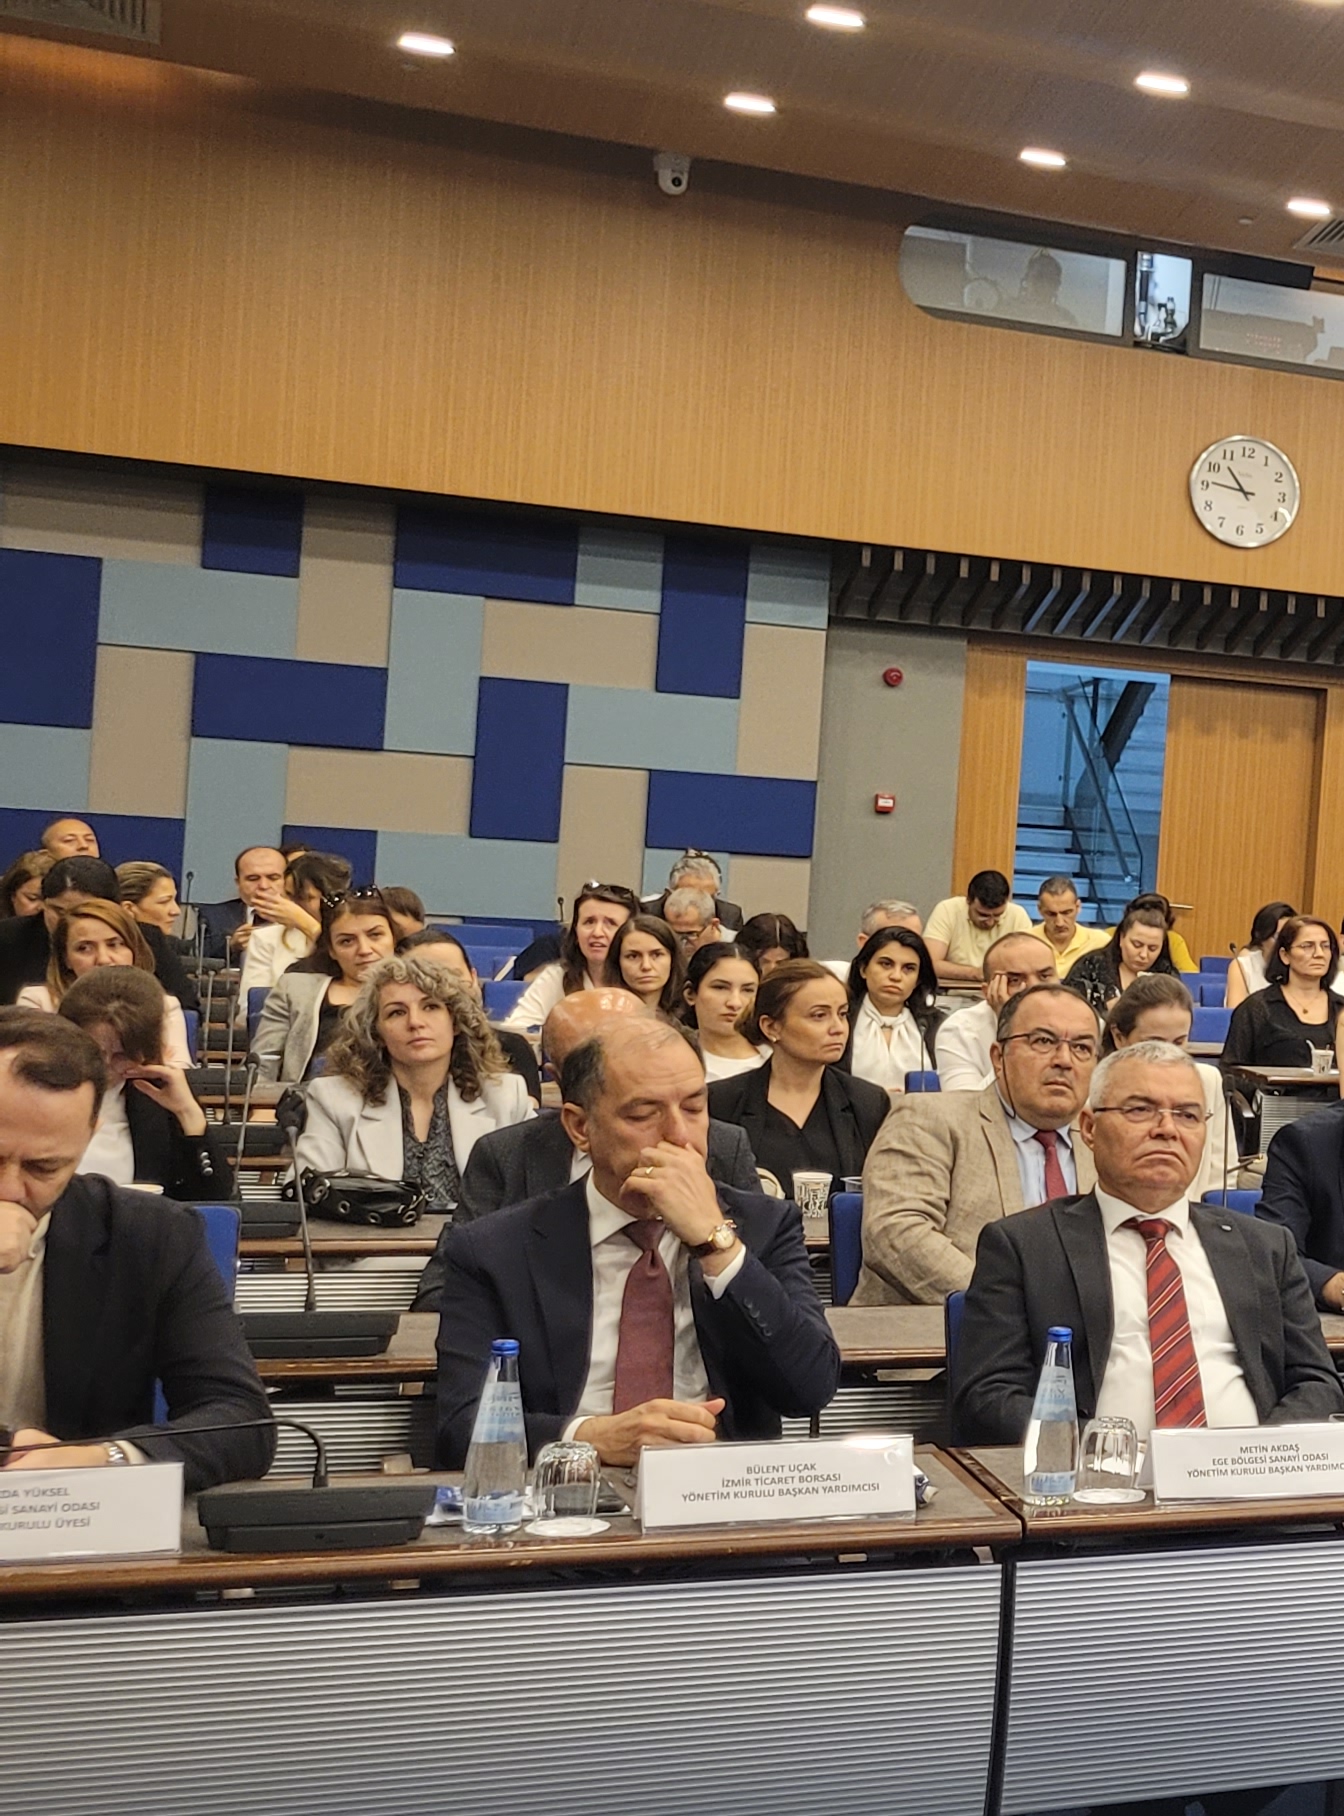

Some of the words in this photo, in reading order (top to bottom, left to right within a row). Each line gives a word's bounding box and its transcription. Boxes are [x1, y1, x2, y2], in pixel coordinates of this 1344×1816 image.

[1222, 449, 1235, 461] 11
[1241, 446, 1256, 459] 12
[1263, 455, 1270, 467] 1
[1207, 461, 1221, 474] 10
[1274, 471, 1284, 483] 2
[1201, 479, 1210, 491] 9
[1277, 492, 1287, 504] 3
[1203, 500, 1213, 512] 8
[1217, 516, 1226, 528] 7
[1270, 510, 1279, 522] 4
[1235, 525, 1245, 536] 6
[1255, 523, 1264, 535] 5
[1240, 1443, 1268, 1454] METİN
[1270, 1444, 1300, 1455] AKDAŞ
[1212, 1458, 1229, 1466] EGE
[1231, 1454, 1267, 1466] BÖLGESİ
[1269, 1452, 1300, 1464] SANAYİ
[1302, 1452, 1329, 1462] ODASI
[746, 1463, 786, 1474] BÜLENT
[788, 1462, 817, 1474] UÇAK
[1187, 1466, 1229, 1479] YÖNETİM
[1230, 1466, 1266, 1476] KURULU
[1268, 1464, 1304, 1476] BAŞKAN
[721, 1474, 752, 1488] İZMİR
[754, 1474, 796, 1487] TİCARET
[798, 1472, 842, 1486] BORSASI
[24, 1487, 71, 1498] YÜKSEL
[682, 1489, 731, 1503] YÖNETİM
[734, 1488, 775, 1500] KURULU
[778, 1486, 820, 1499] BAŞKAN
[821, 1482, 880, 1496] YARDIMCISI
[12, 1502, 58, 1514] SANAYİ
[61, 1502, 101, 1512] ODASI
[55, 1516, 91, 1529] ÜYESİ
